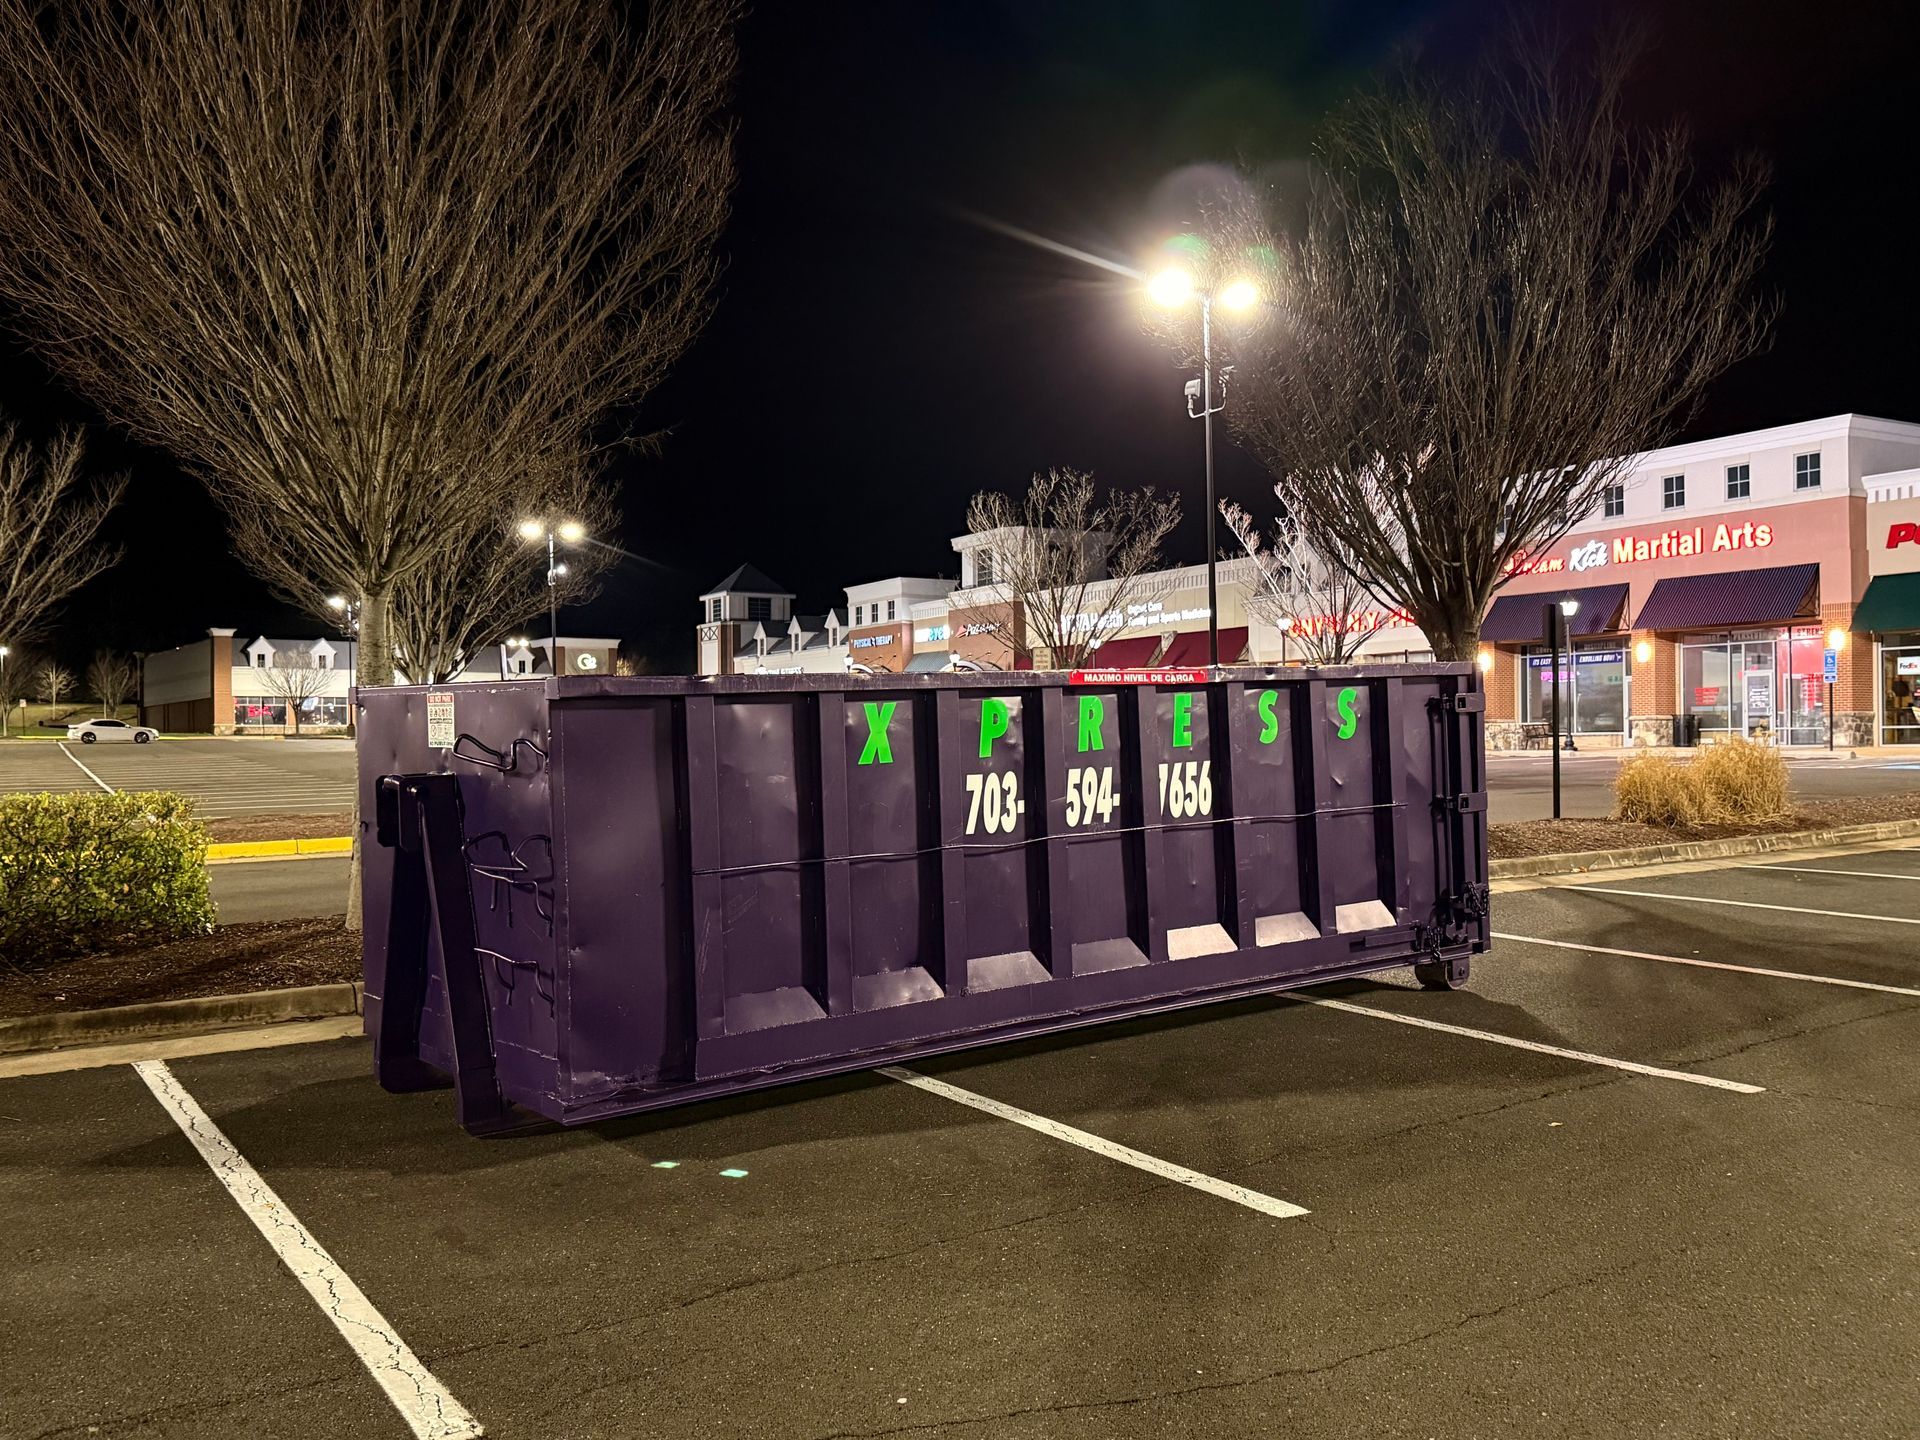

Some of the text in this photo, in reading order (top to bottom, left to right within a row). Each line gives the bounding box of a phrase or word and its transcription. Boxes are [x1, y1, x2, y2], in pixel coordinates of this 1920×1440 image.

[1569, 539, 1609, 571] Kick
[1612, 528, 1703, 564] Martial
[1711, 521, 1773, 552] Arts
[1084, 673, 1194, 683] MAXIMO NIVEL DE CARGA
[965, 771, 1024, 834] 703-
[1066, 767, 1120, 827] 594-
